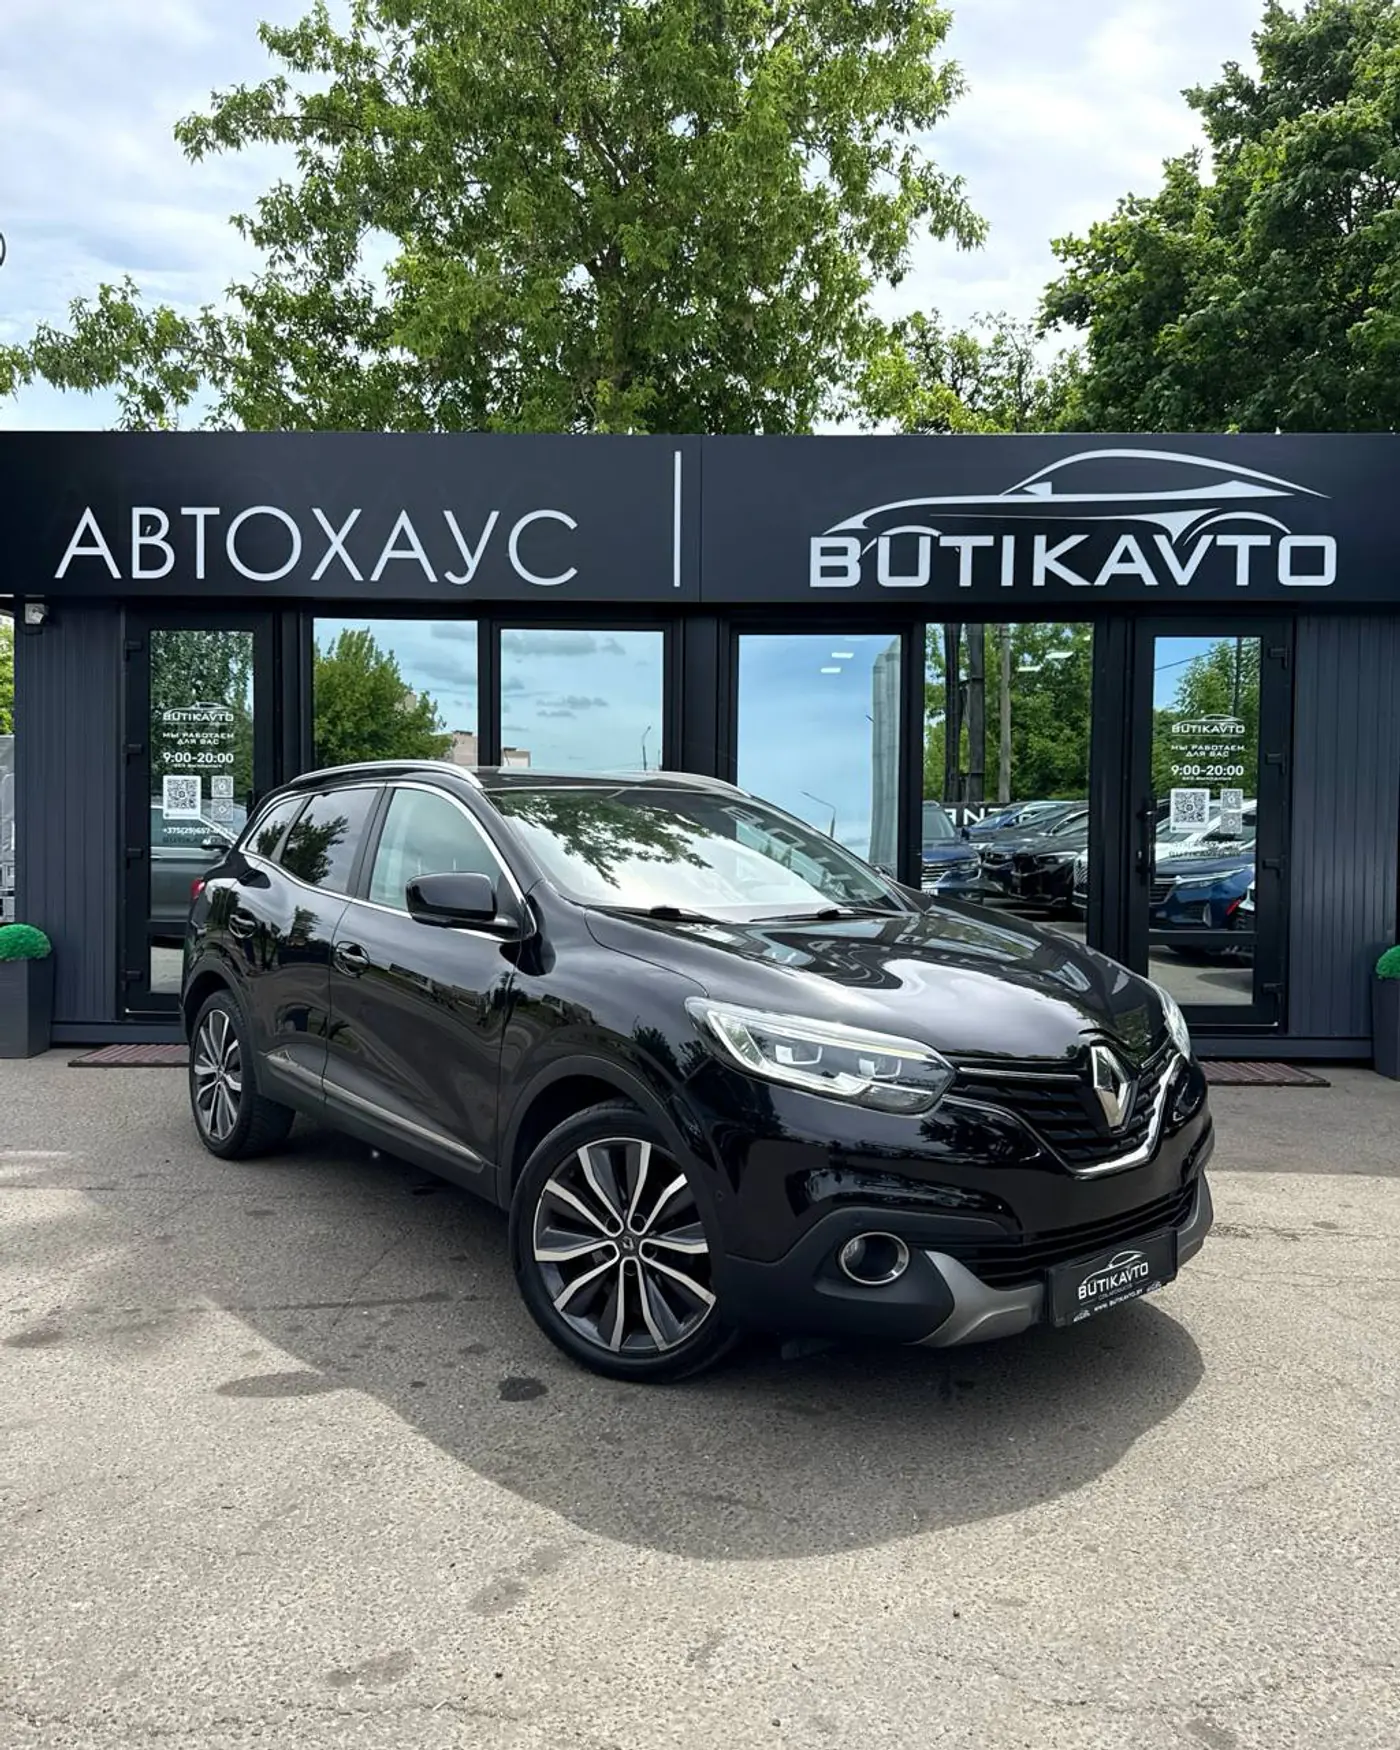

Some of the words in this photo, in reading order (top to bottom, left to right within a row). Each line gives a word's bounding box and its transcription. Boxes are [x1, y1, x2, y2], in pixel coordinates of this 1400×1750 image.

[55, 505, 578, 586] АВТОХАУС
[809, 535, 1337, 587] BUTIKAVTO
[163, 712, 234, 722] BUTIKAVTO
[1171, 724, 1245, 734] BUTIKAVTO
[163, 752, 234, 763] 9:00-20:00
[1170, 765, 1244, 776] 9:00-20:00
[1078, 1262, 1149, 1300] BUTIKAVTO
